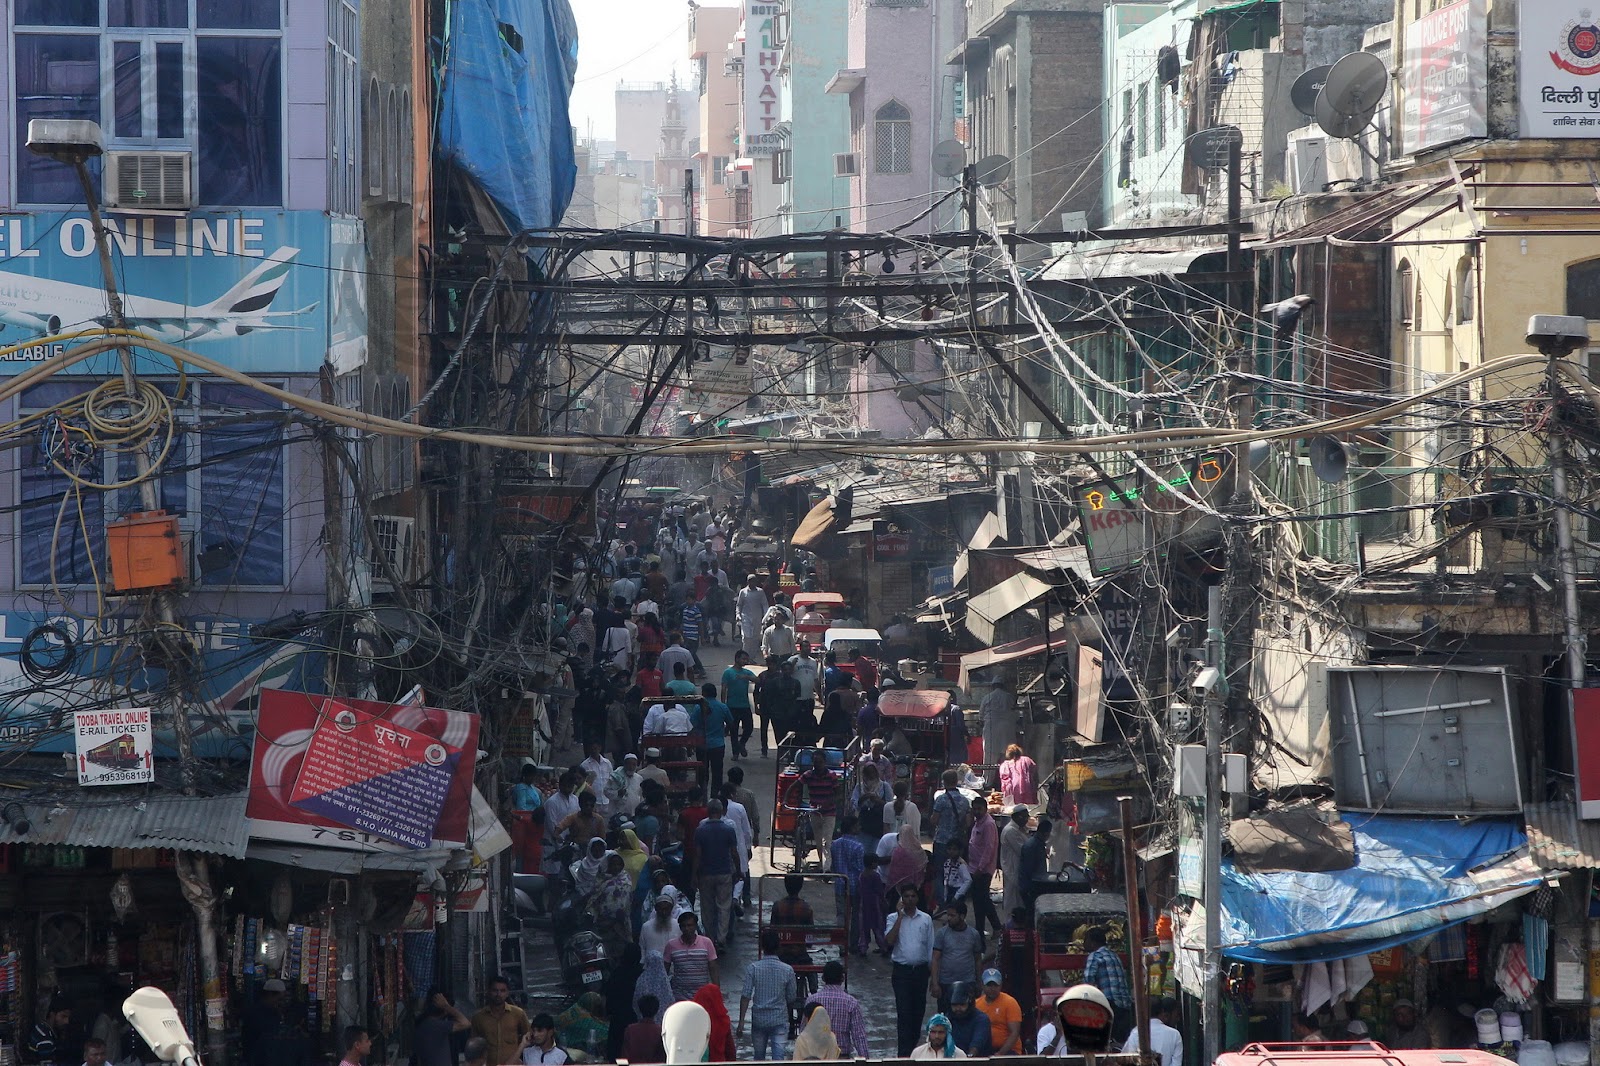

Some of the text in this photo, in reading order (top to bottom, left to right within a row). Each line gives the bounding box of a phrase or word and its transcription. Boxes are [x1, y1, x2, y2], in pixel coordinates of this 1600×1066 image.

[1424, 3, 1469, 47] POLICE POST
[759, 52, 776, 130] HYATT
[1541, 86, 1583, 103] दिल्ली
[1553, 116, 1596, 126] शान्ति सेवा
[59, 218, 264, 257] ONLINE
[77, 711, 148, 727] TOOBA TRAVEL ONLINE
[110, 724, 147, 734] TICKETS
[374, 724, 412, 749] सूचना
[399, 834, 426, 848] MASJID
